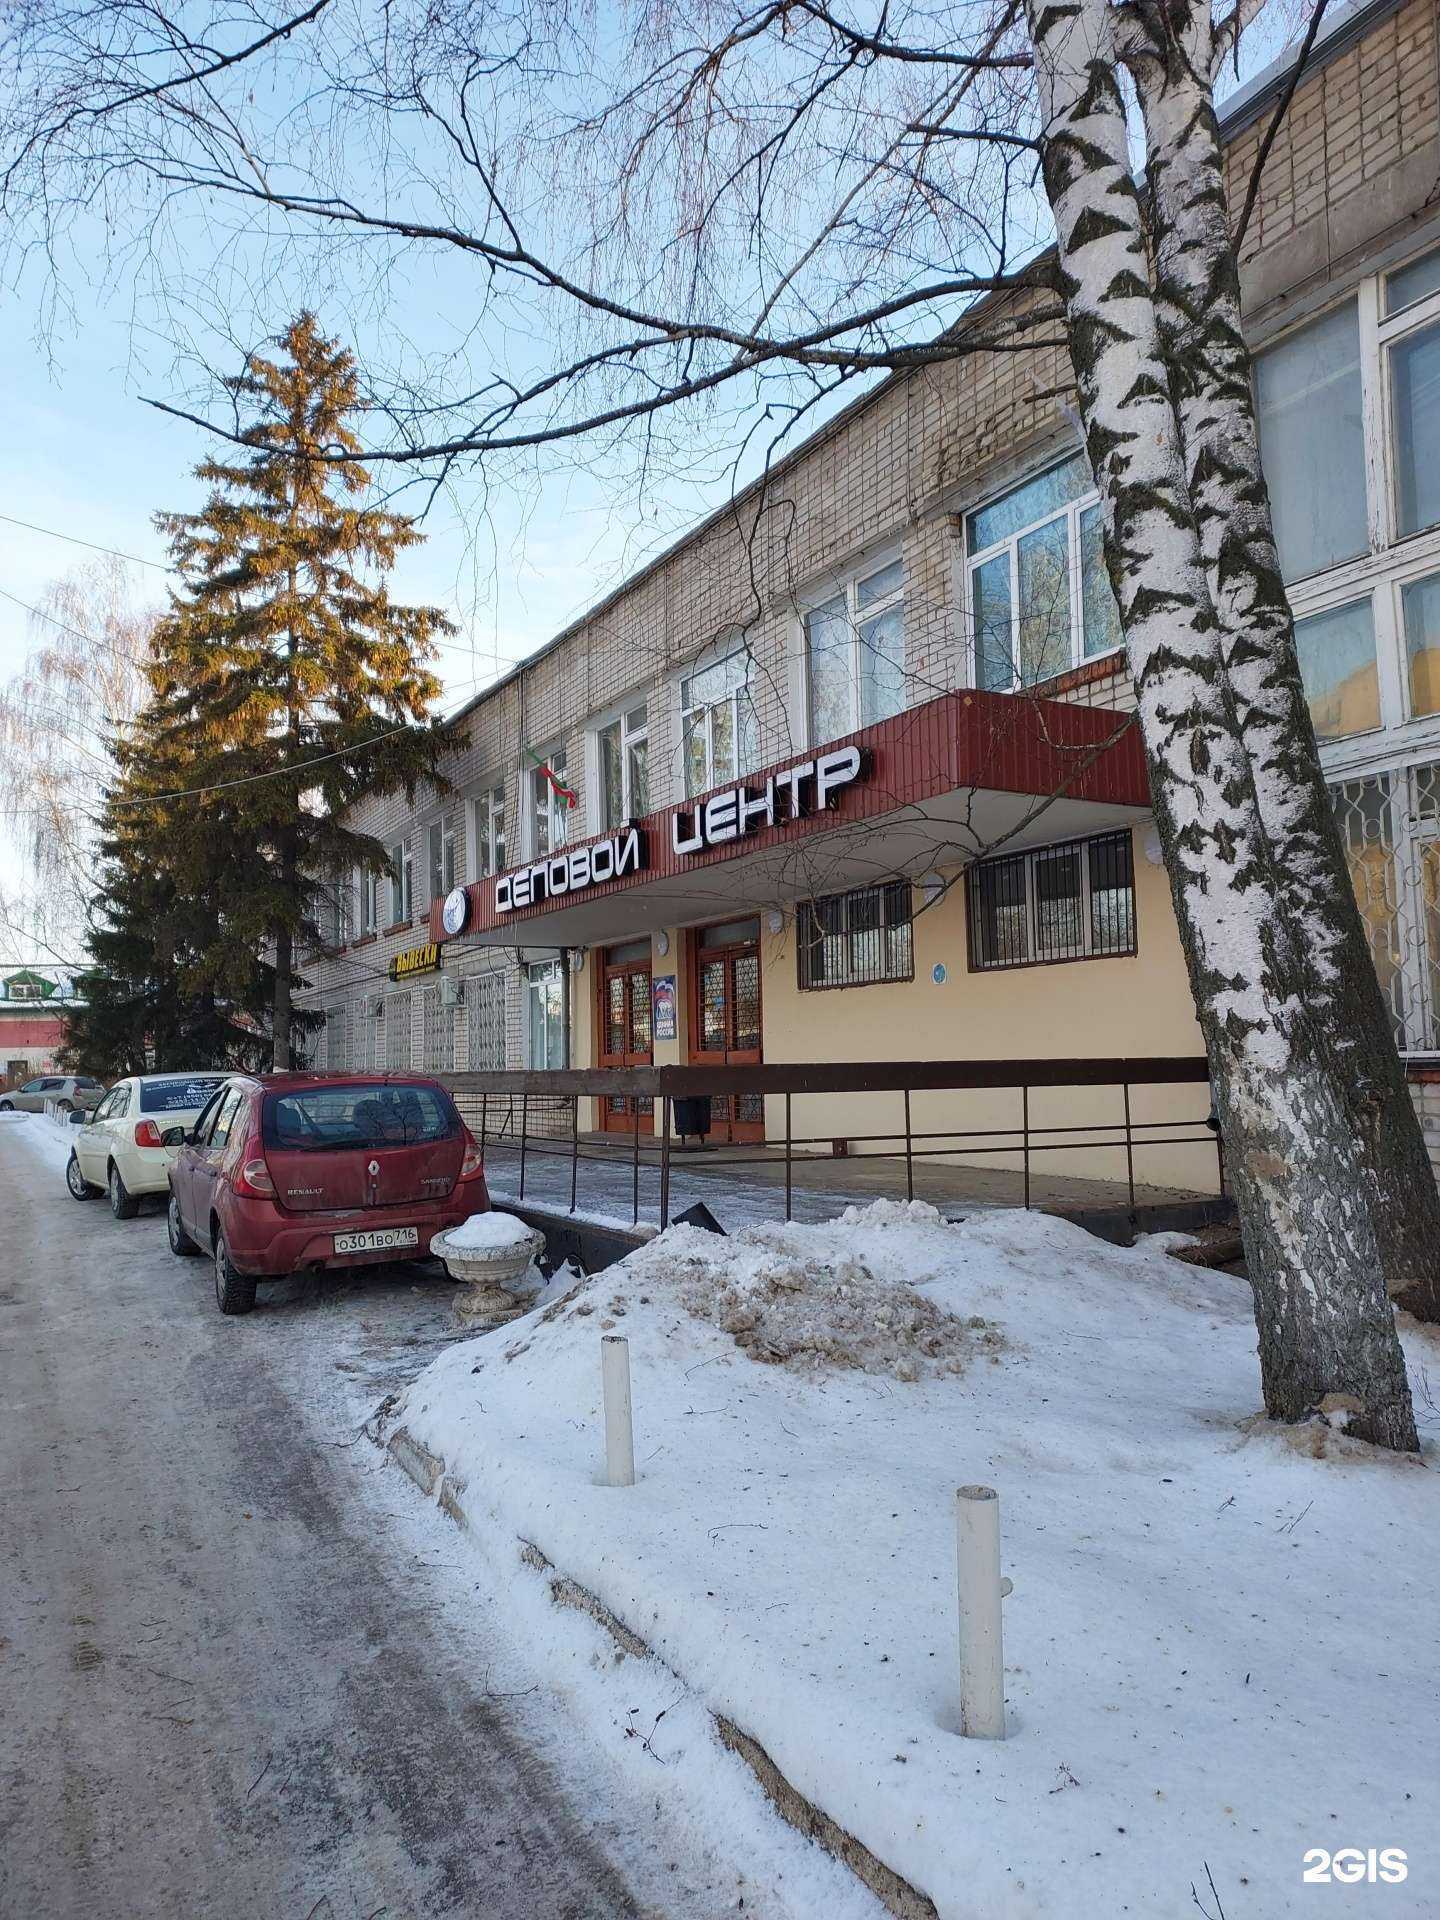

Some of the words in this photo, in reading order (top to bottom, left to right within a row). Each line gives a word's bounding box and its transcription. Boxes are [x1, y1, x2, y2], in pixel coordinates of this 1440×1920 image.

[495, 819, 639, 913] ДЕЛОВОЙ
[672, 745, 862, 855] ЦЕНТР
[396, 943, 438, 972] ВЫВЕСКИ
[287, 1187, 325, 1196] RENAULT
